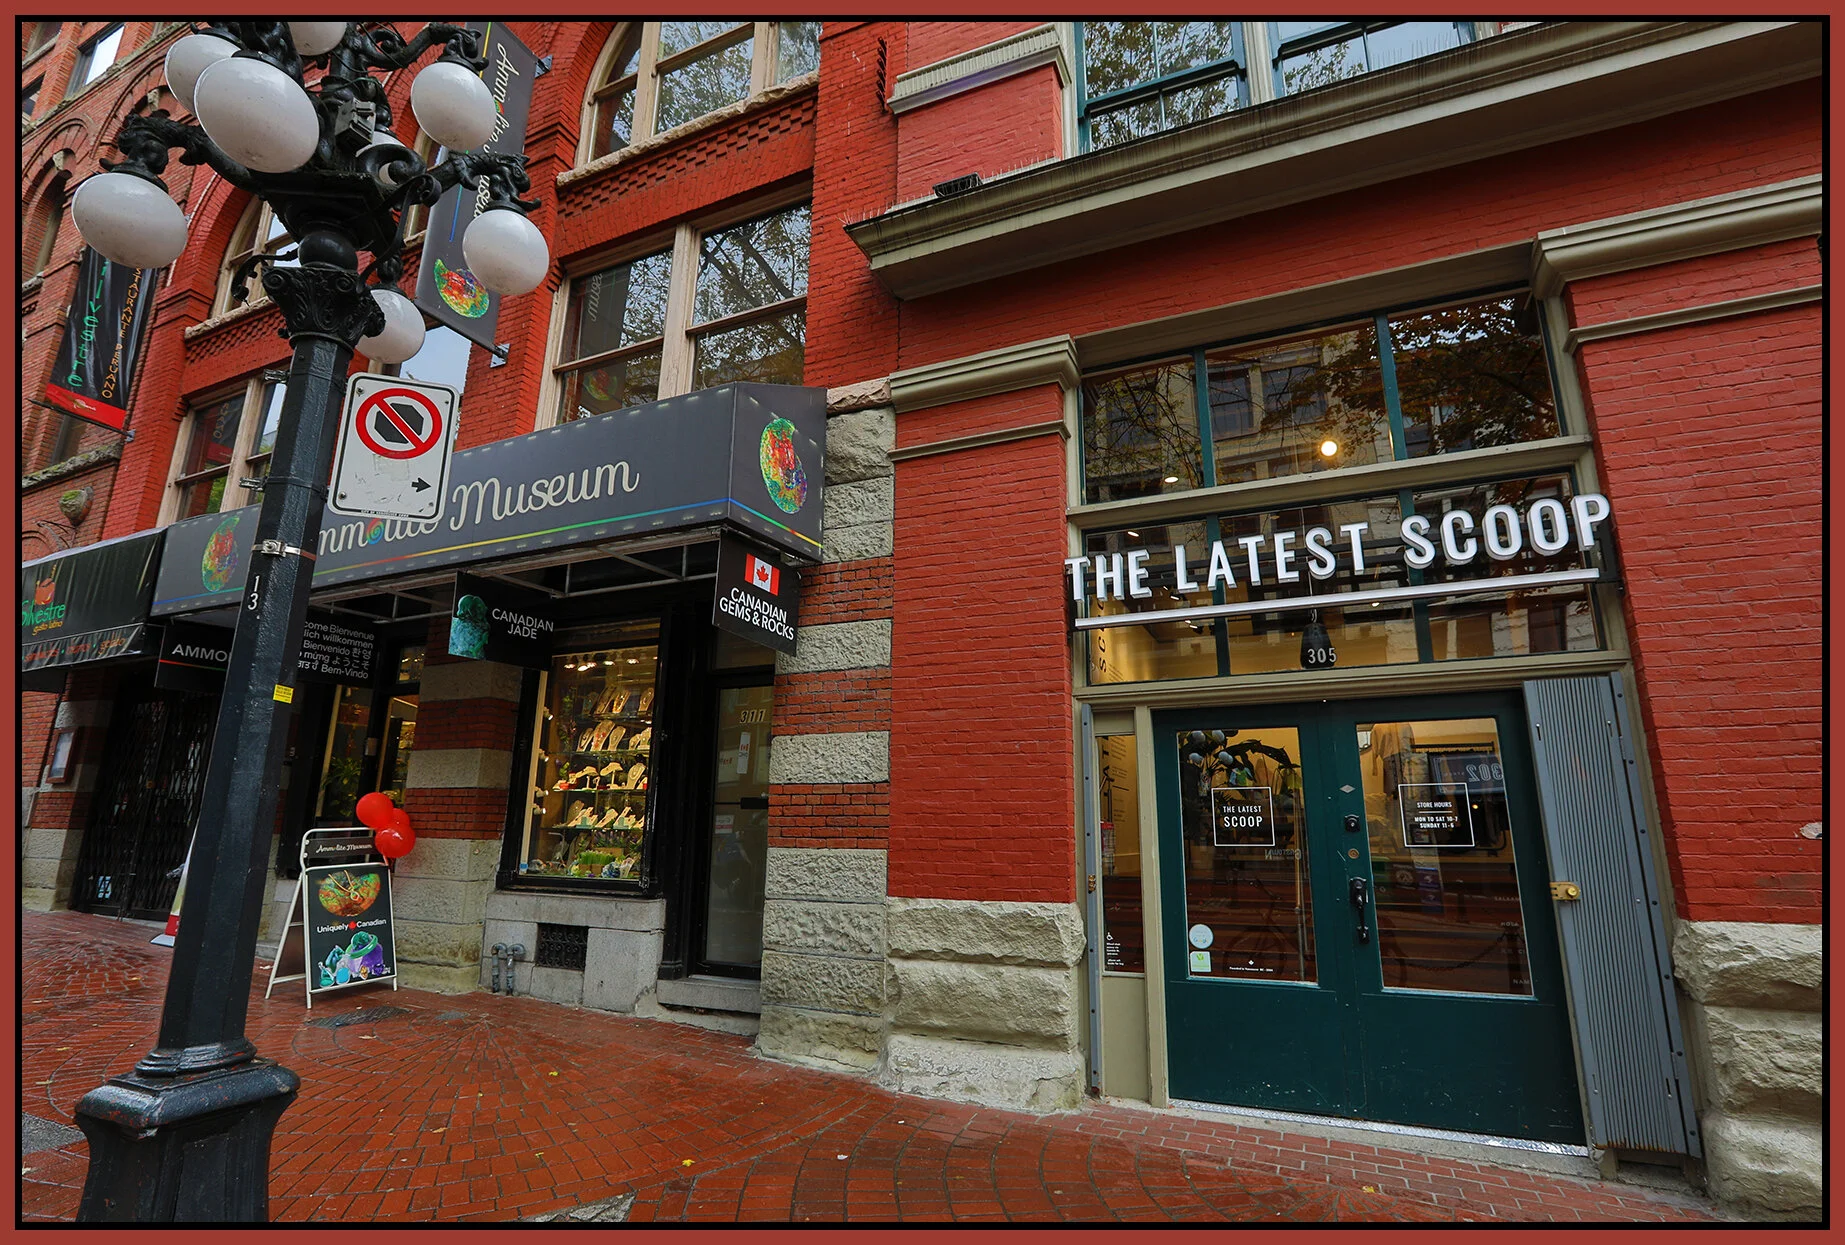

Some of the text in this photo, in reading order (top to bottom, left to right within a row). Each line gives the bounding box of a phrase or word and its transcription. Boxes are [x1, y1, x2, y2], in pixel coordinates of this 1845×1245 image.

[67, 259, 110, 388] ilvestre
[101, 267, 143, 399] STAURANTE PERUANO
[450, 461, 640, 531] Museum
[1064, 493, 1610, 601] THE LATEST SCOOP
[730, 586, 788, 624] CANADIAN
[491, 607, 555, 633] CANADIAN
[719, 596, 795, 641] GEMS & ROCKS
[329, 624, 375, 641] Bienvenue
[507, 623, 538, 640] JADE
[303, 639, 351, 656] Bienvenido
[322, 634, 374, 650] willkommen
[171, 643, 231, 662] AMMO
[1307, 647, 1337, 664] 305
[321, 664, 369, 680] Bem-Vindo
[739, 709, 766, 724] 311
[1223, 805, 1262, 813] THE LATEST
[1223, 815, 1263, 828] SCOOP
[316, 918, 387, 934] Uniquely Canadian
